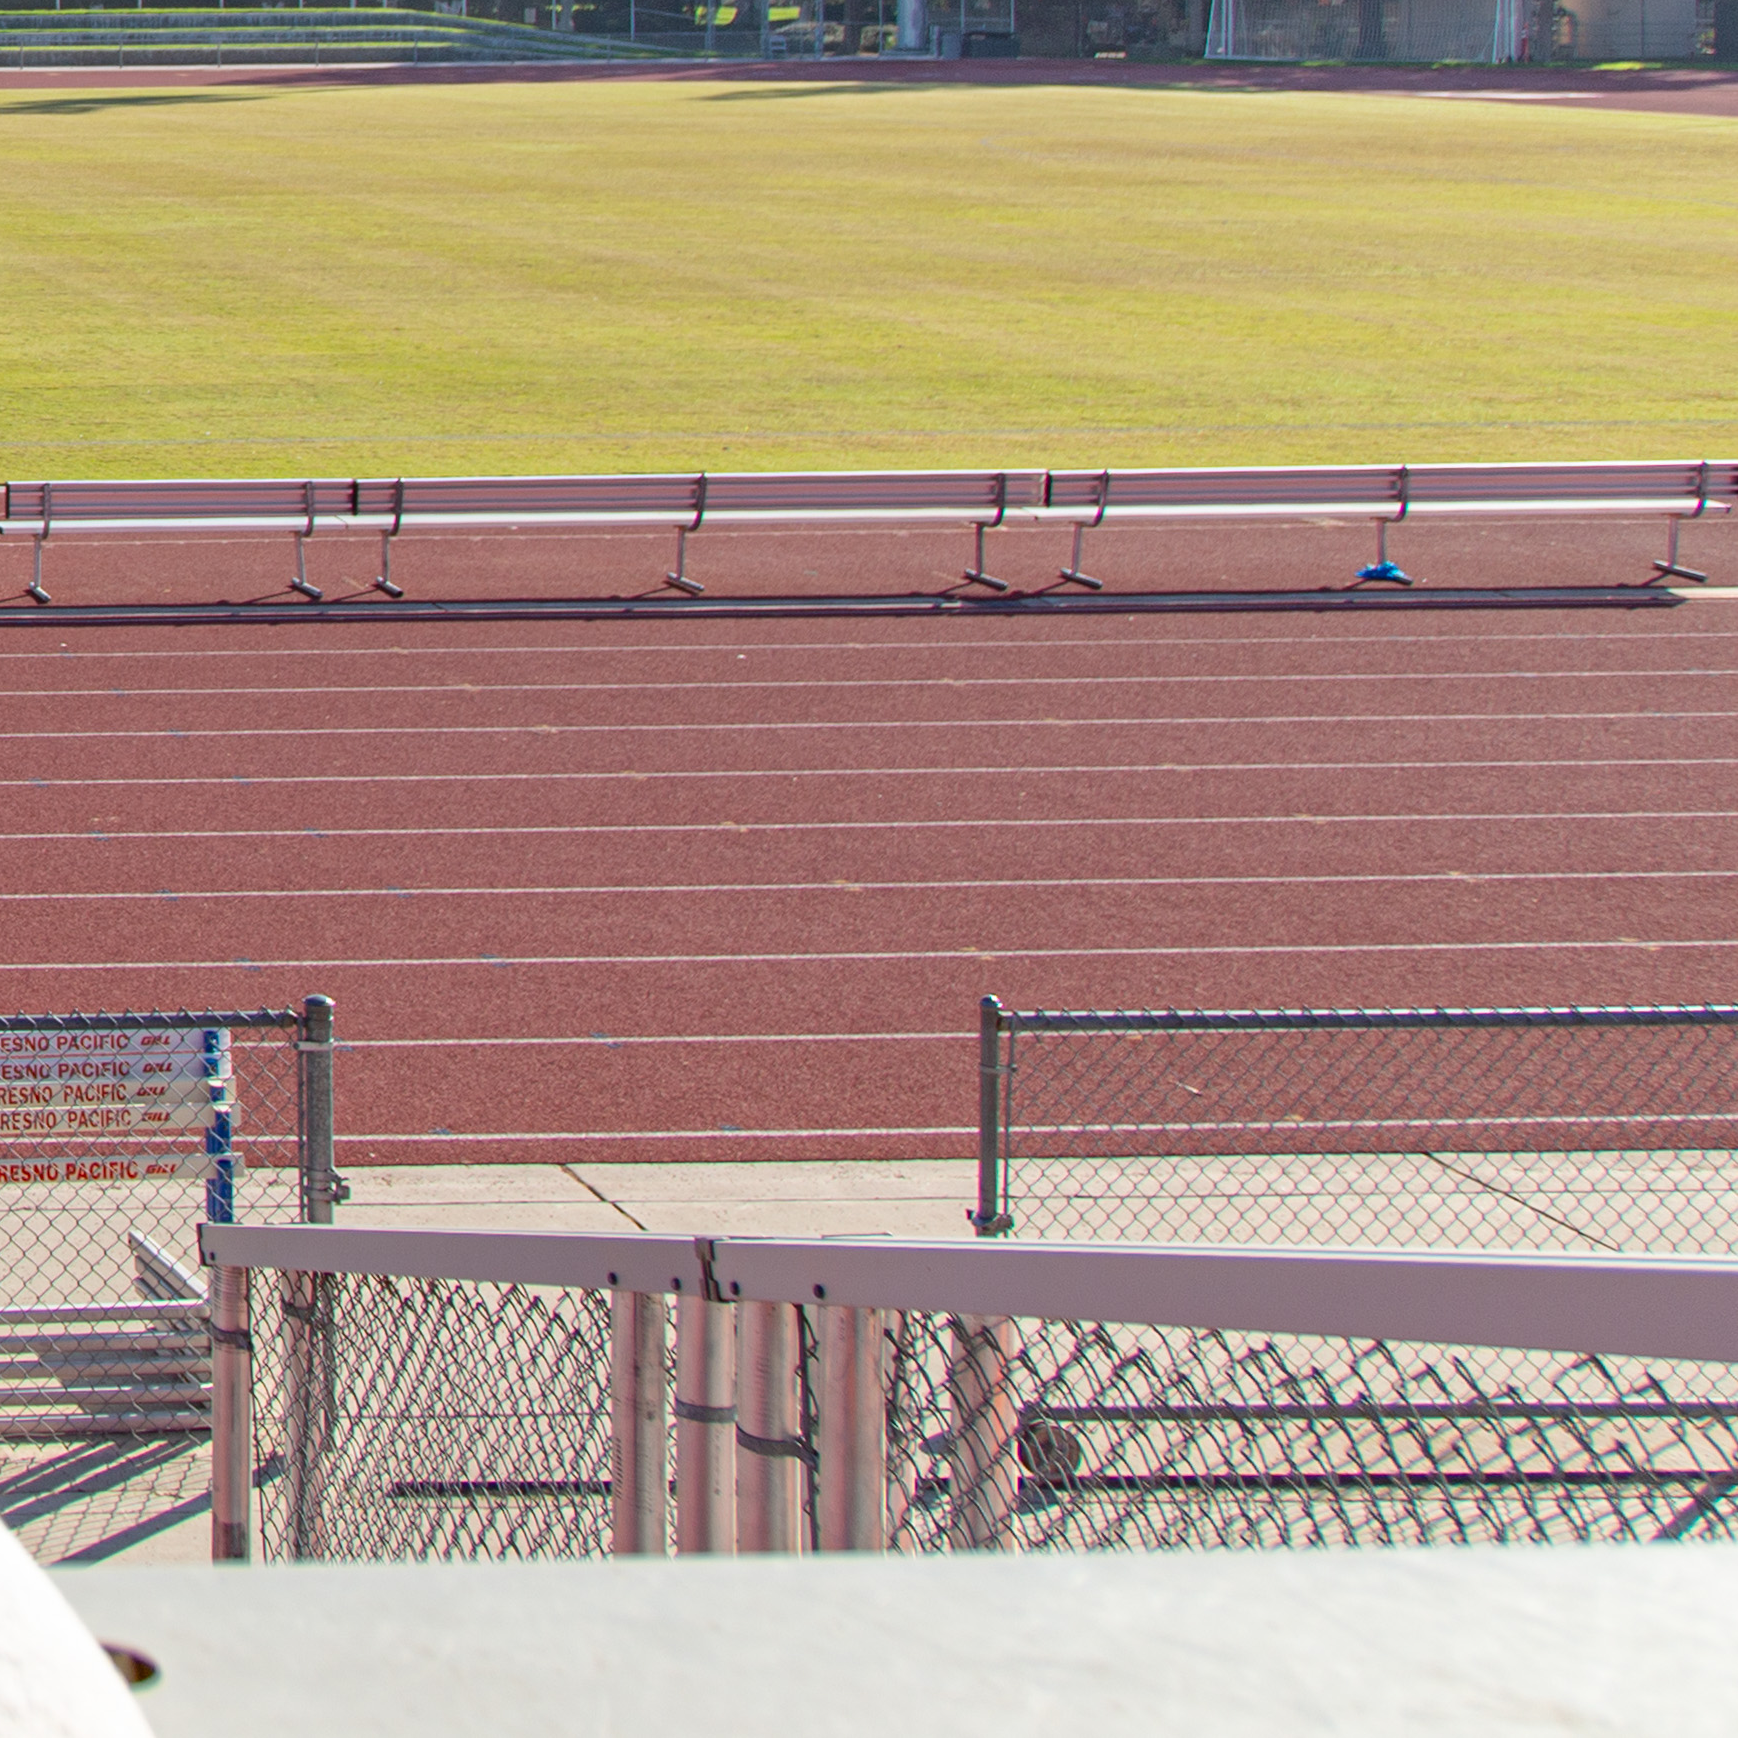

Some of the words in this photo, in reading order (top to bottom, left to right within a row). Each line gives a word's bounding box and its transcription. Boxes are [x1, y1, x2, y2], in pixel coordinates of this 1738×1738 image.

[56, 1034, 129, 1050] PACIFIC
[58, 1061, 130, 1078] PACIFIC
[63, 1083, 127, 1103] PACIFIC
[67, 1110, 131, 1129] PACIFIC
[65, 1161, 139, 1181] PACIFIC
